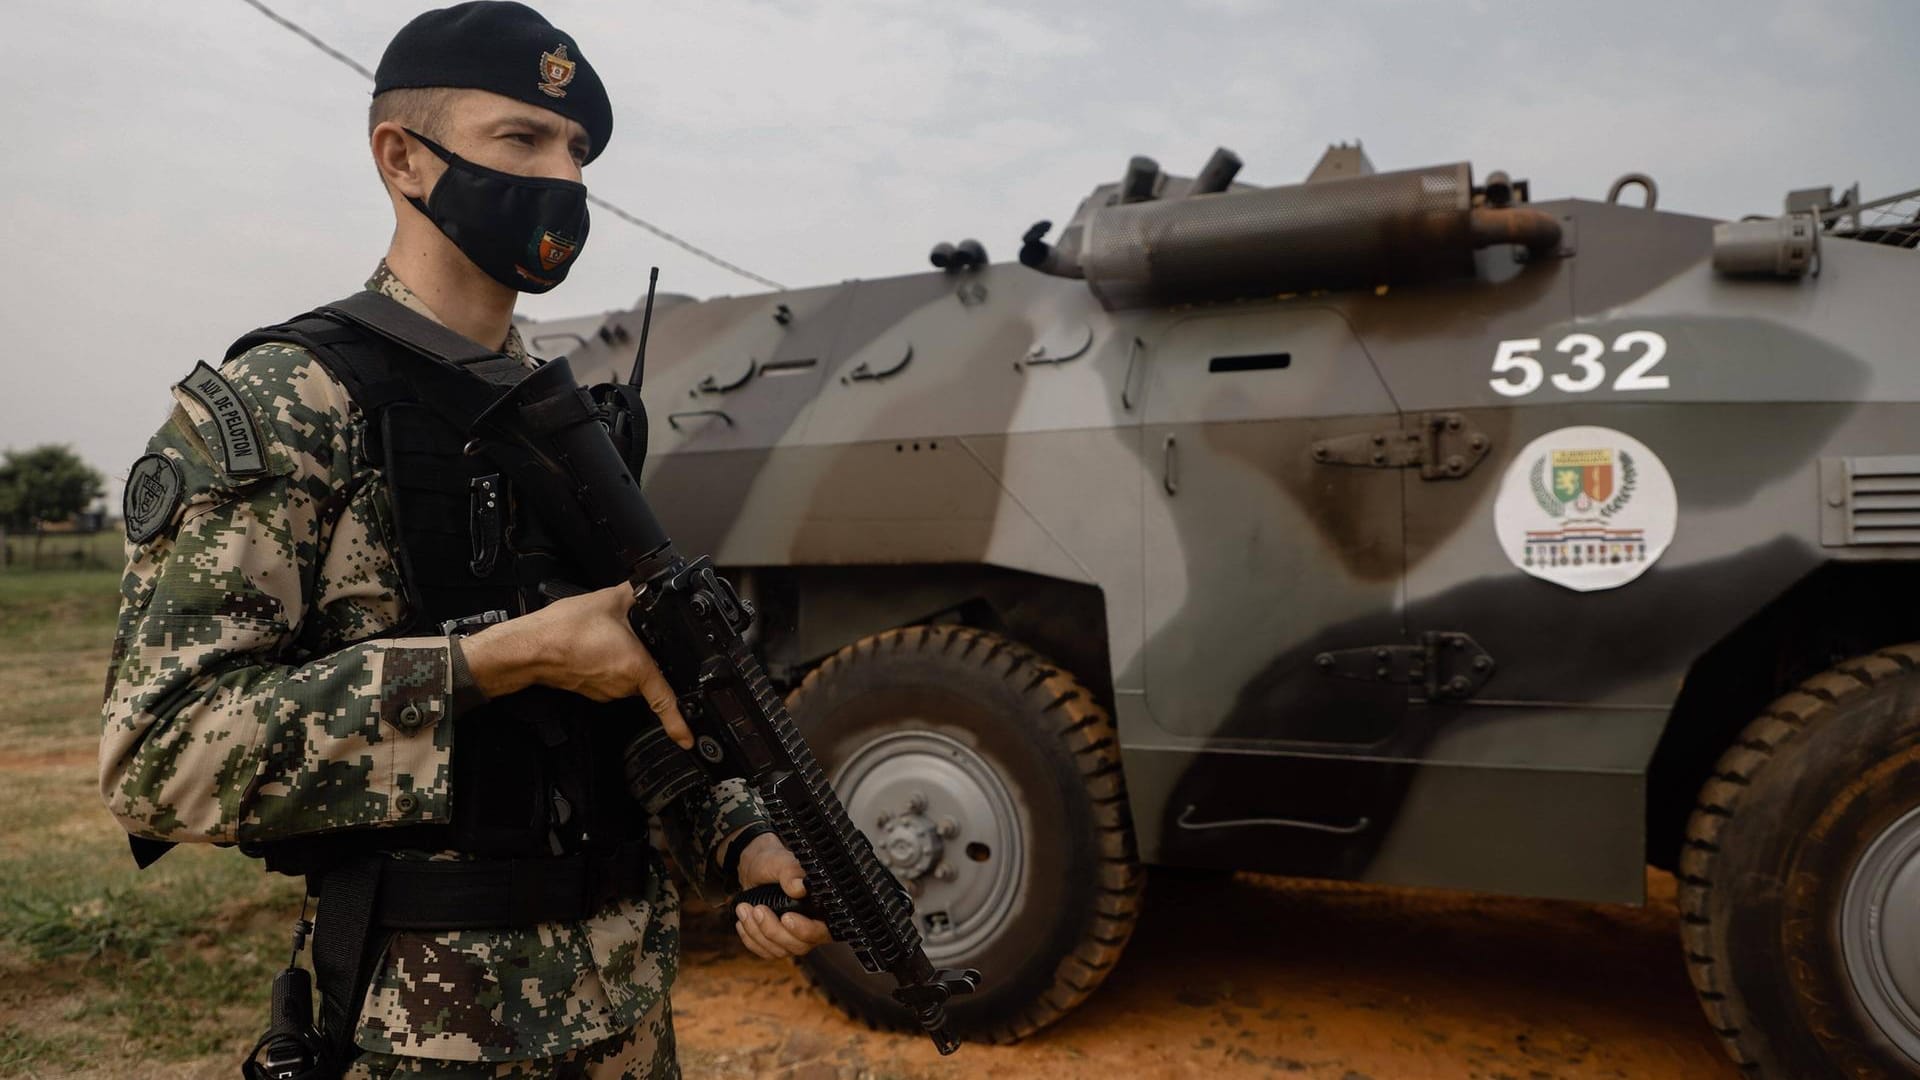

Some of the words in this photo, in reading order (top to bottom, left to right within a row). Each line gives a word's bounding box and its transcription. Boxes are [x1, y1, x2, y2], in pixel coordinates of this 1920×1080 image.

[1488, 330, 1670, 397] 532
[214, 395, 234, 412] DE
[221, 410, 253, 458] PELOTON
